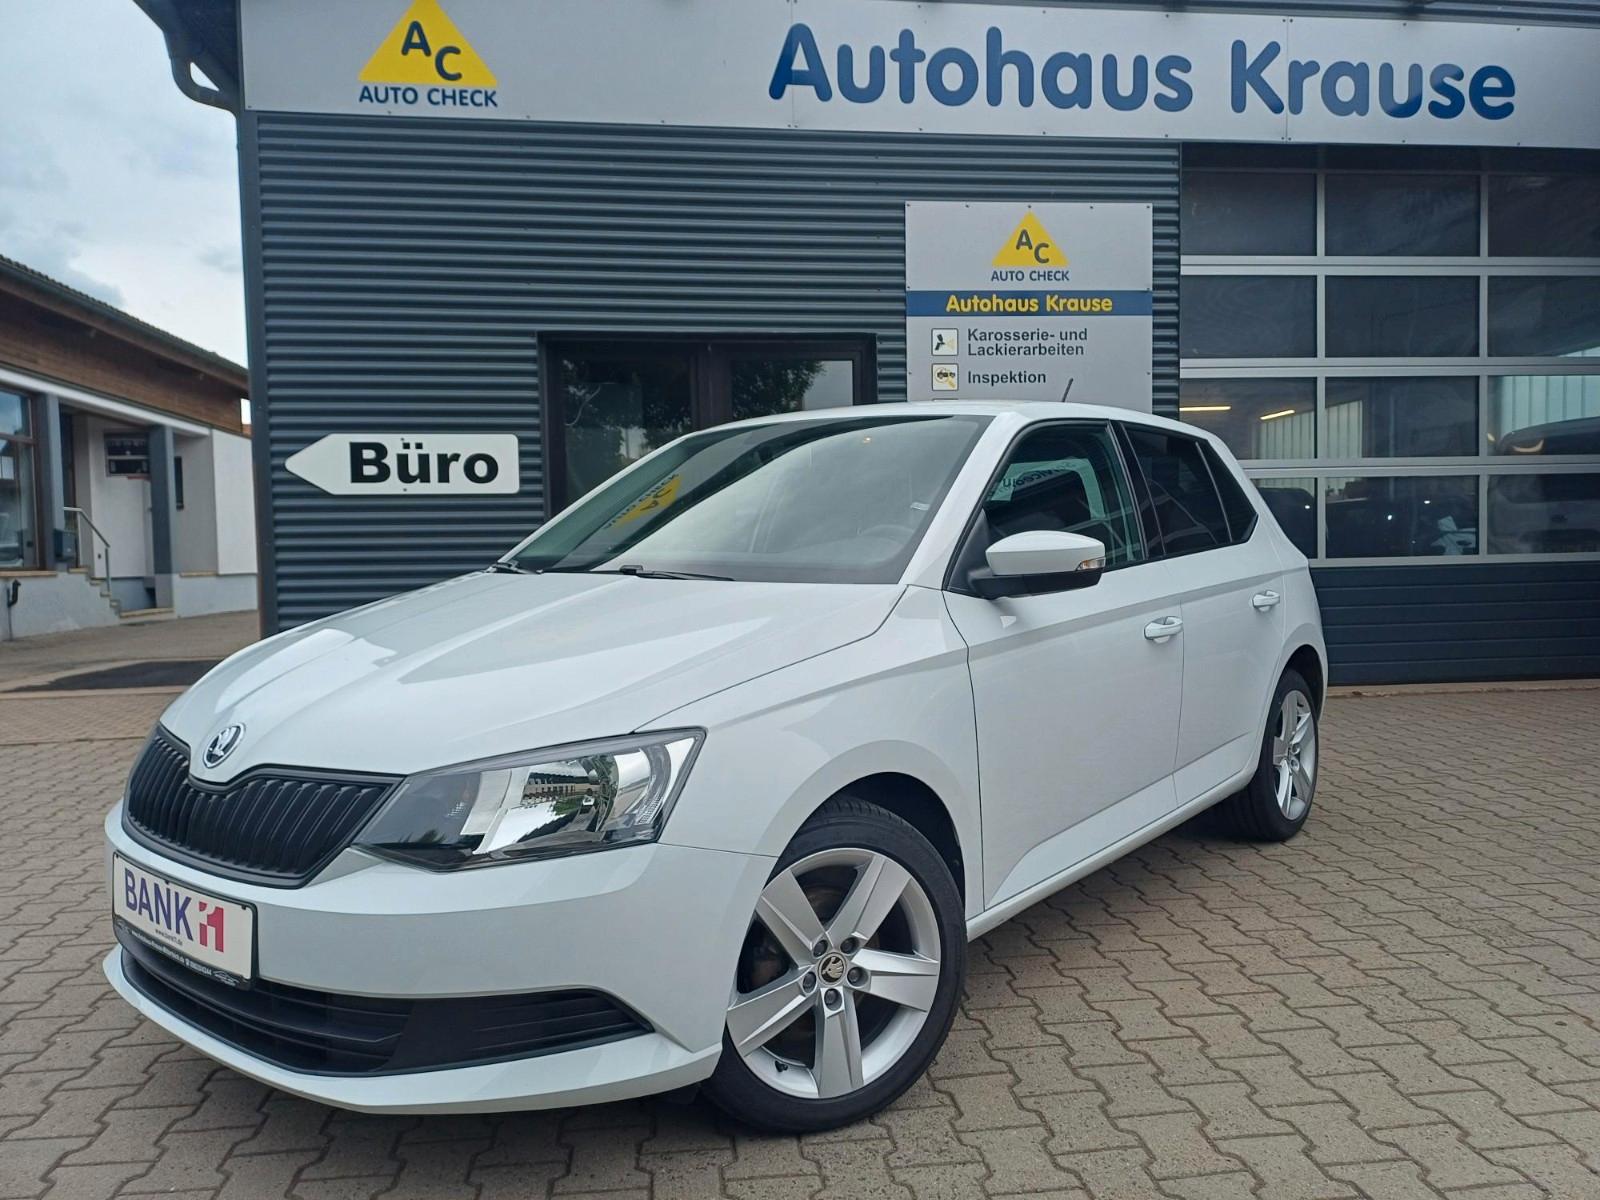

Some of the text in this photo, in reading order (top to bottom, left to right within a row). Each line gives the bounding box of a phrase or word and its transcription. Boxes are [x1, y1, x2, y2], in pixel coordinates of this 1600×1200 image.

[768, 22, 1517, 121] Autohaus Krause
[359, 85, 498, 108] AUTO CHECK
[990, 270, 1070, 282] AUTO CHECK
[945, 294, 1113, 313] Autohaus Krause
[967, 328, 1088, 341] Karosserie- und
[967, 343, 1084, 357] Lackierarbeiten
[967, 370, 1047, 386] Inspektion
[349, 441, 499, 485] Büro
